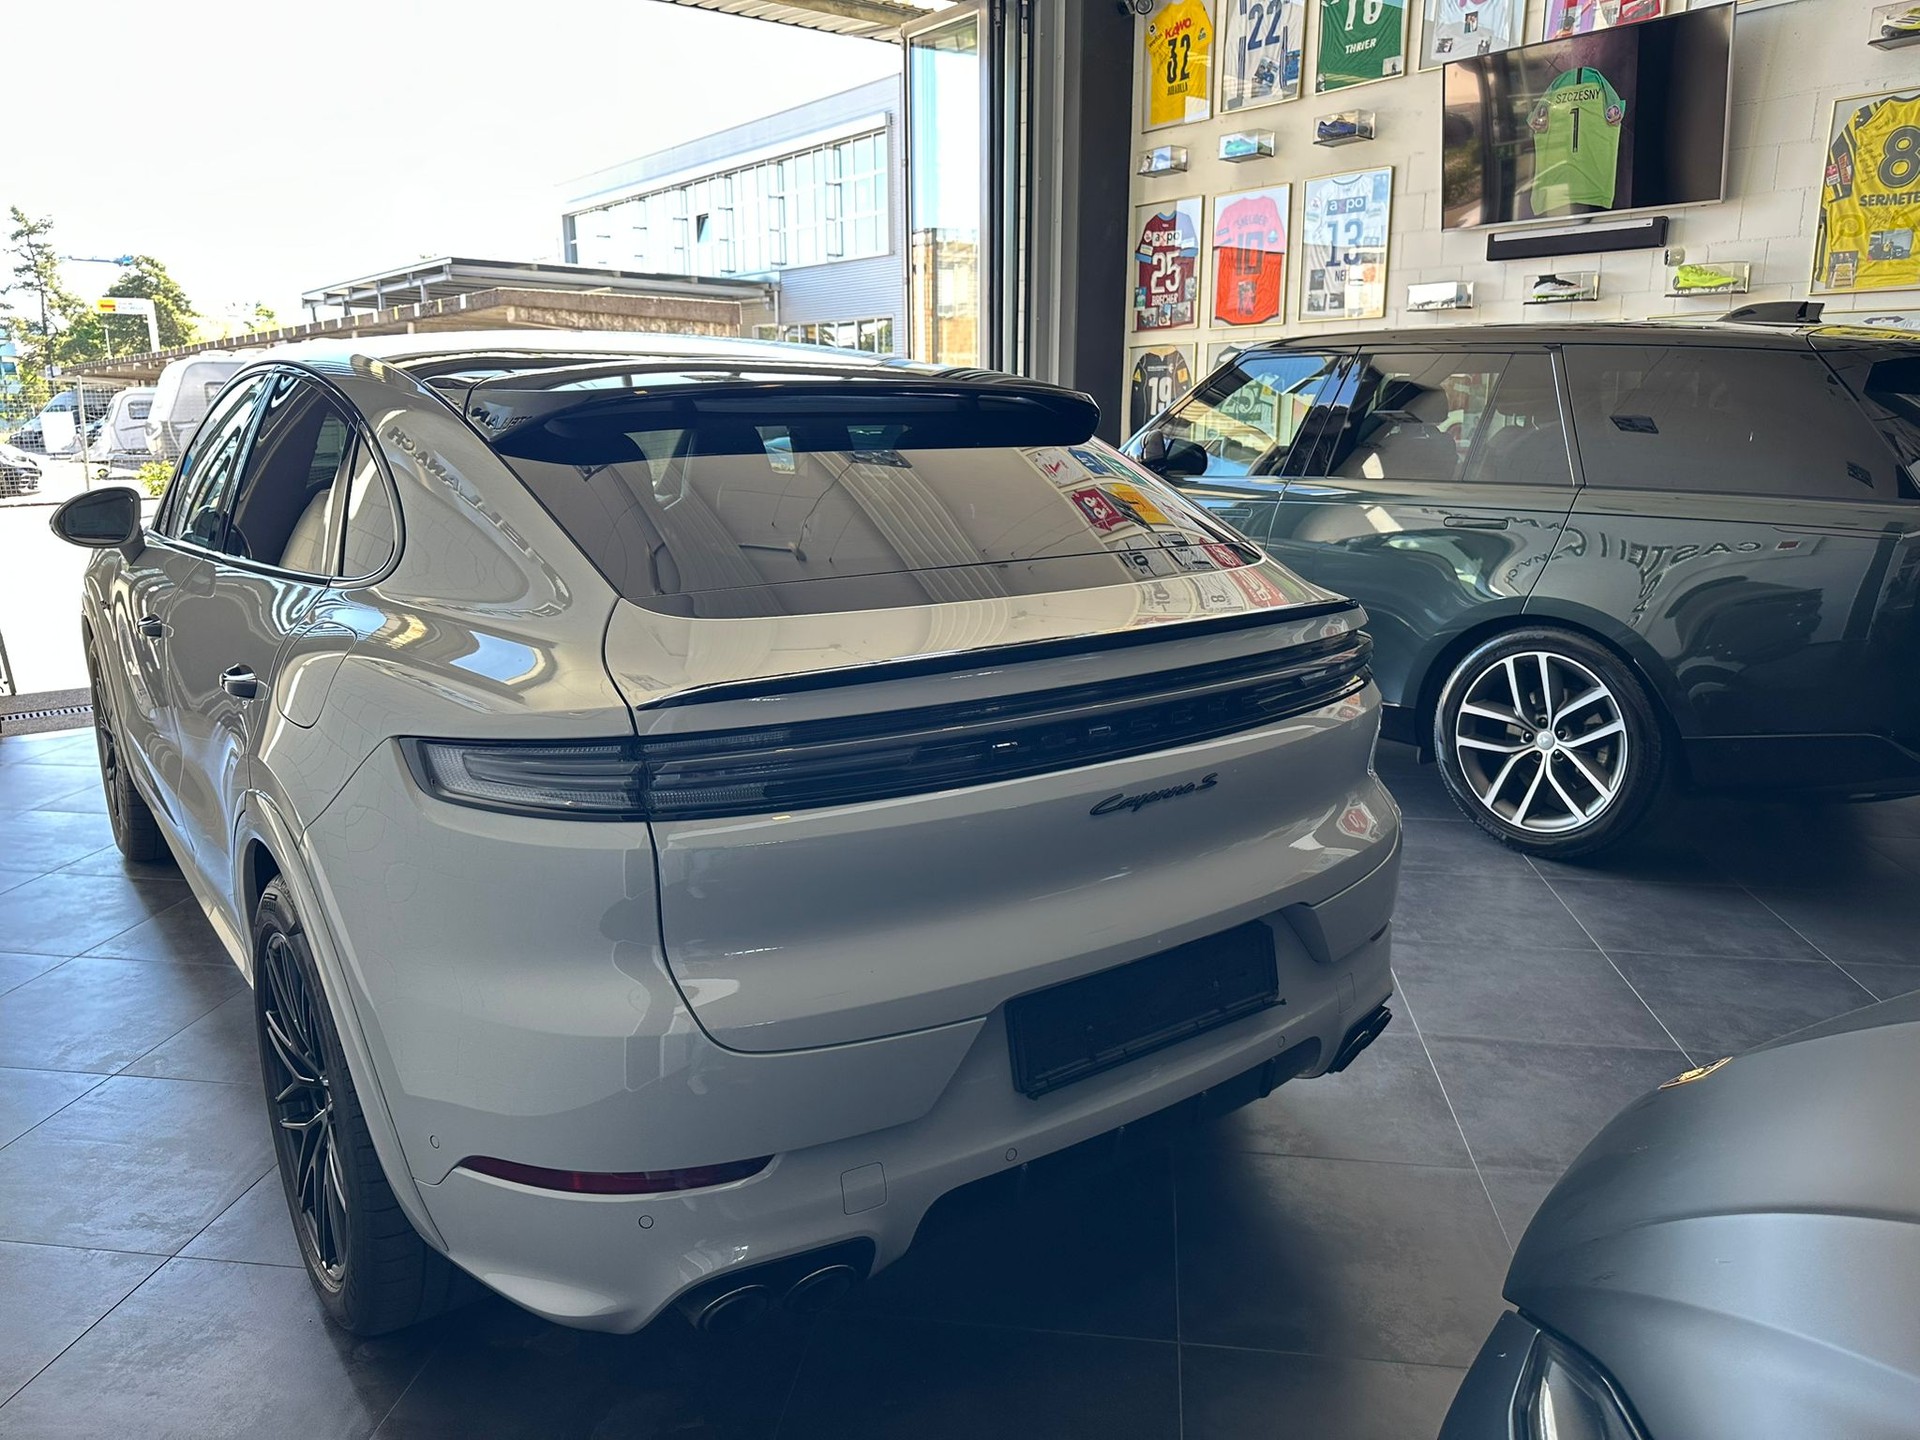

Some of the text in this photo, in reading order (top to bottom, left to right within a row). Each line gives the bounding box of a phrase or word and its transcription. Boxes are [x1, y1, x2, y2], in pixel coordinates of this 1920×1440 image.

[1247, 0, 1282, 51] 22
[1167, 34, 1191, 84] 32
[1570, 107, 1580, 153] 1
[1878, 125, 1920, 188] 8
[1237, 230, 1264, 276] 10
[1326, 218, 1364, 267] 13
[1151, 250, 1182, 294] 25
[1148, 377, 1173, 416] 19
[1089, 772, 1218, 816] Cayenne S
